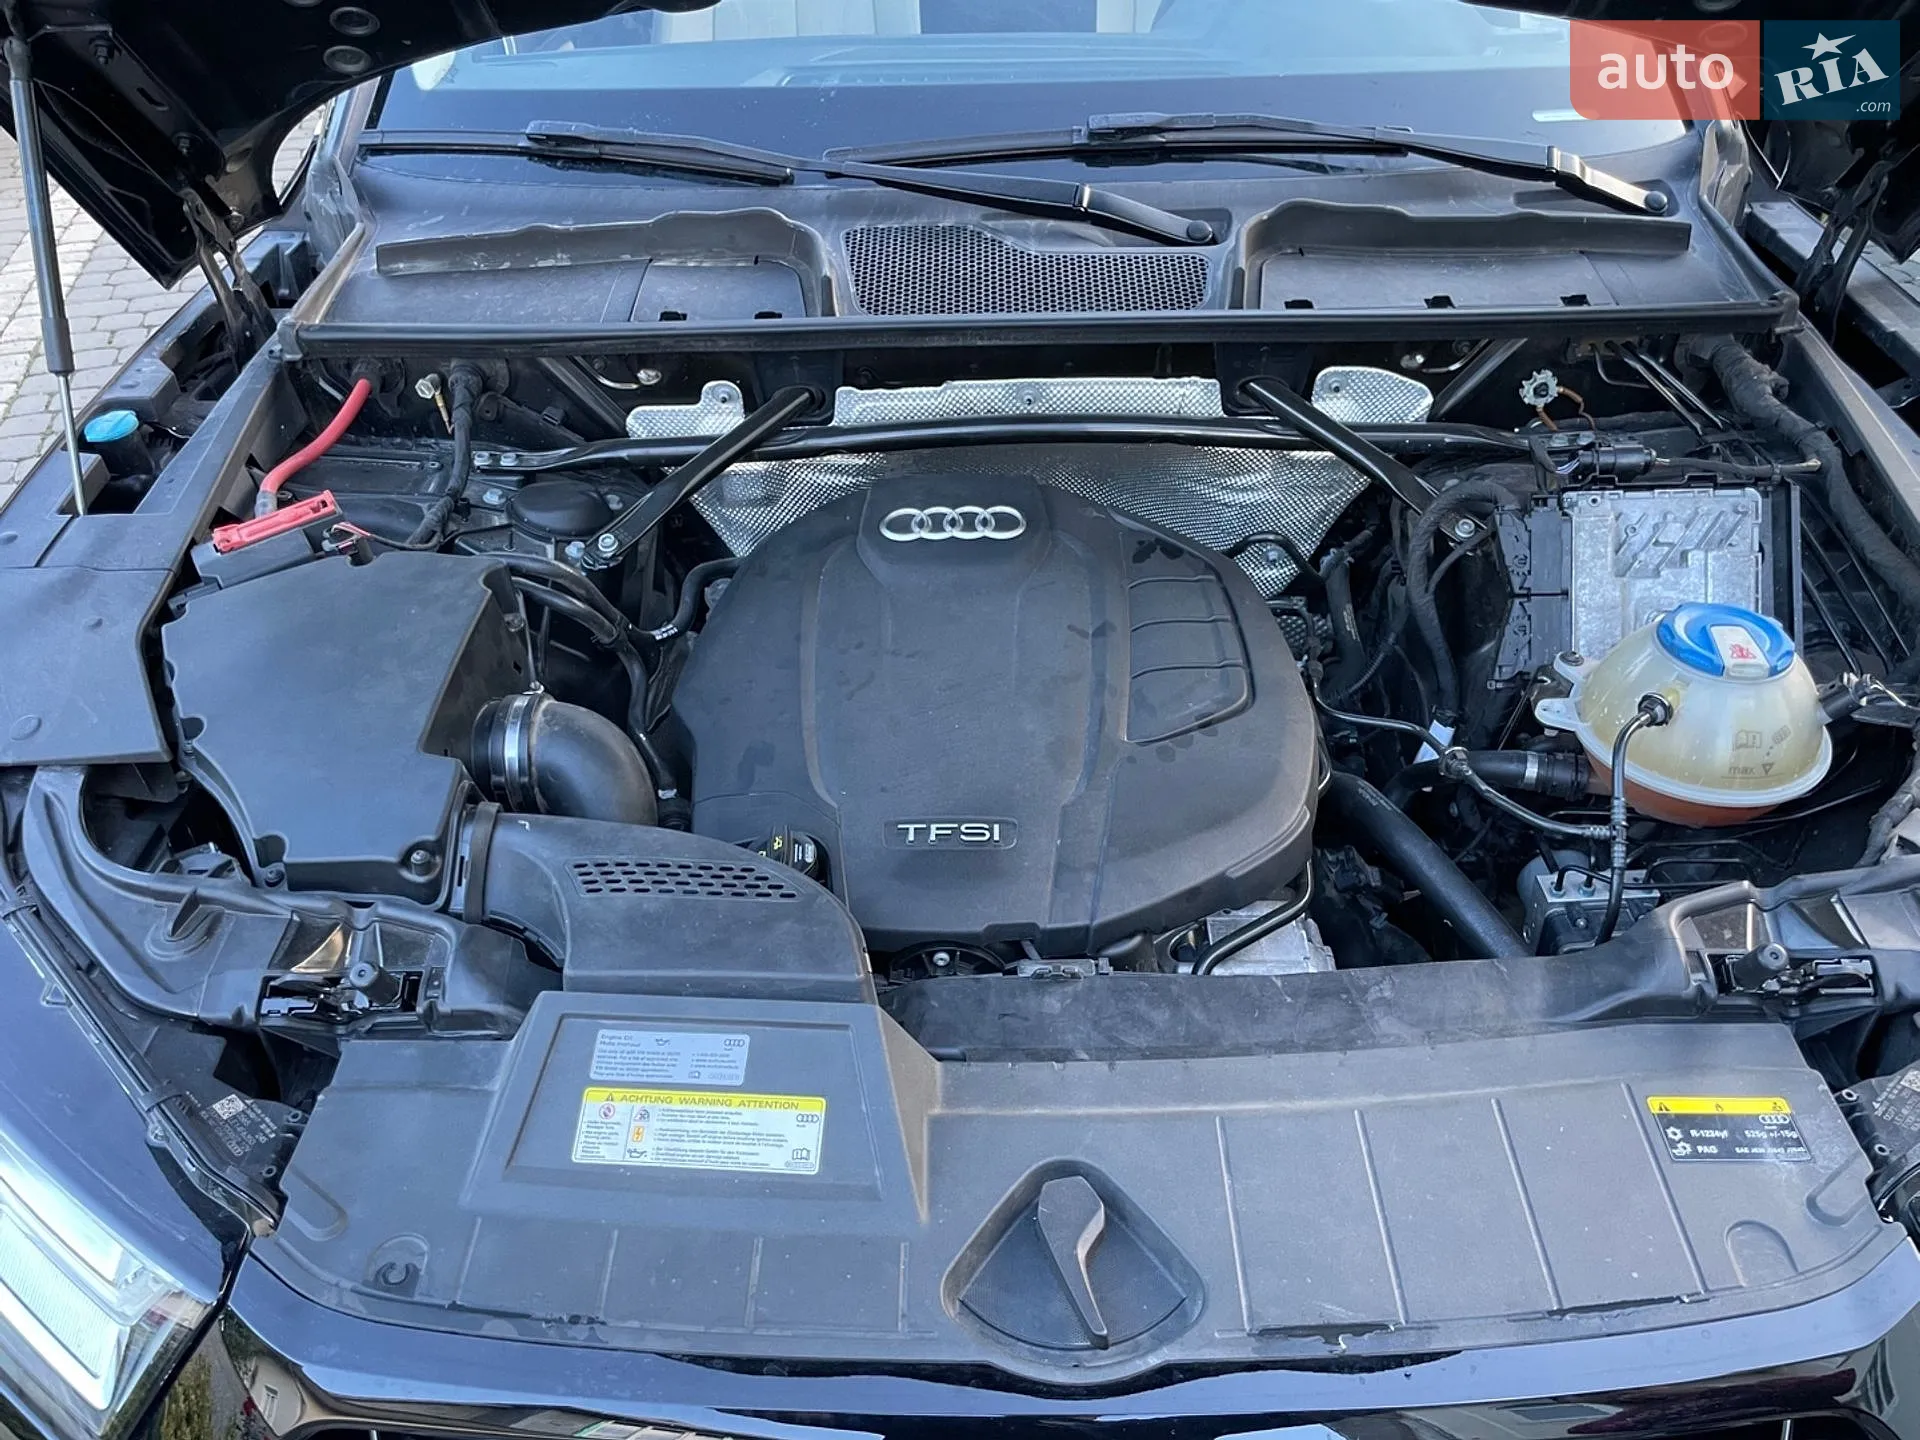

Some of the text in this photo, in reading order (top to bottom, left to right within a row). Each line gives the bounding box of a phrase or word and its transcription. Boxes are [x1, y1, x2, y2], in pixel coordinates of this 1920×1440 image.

[1728, 764, 1756, 775] max
[897, 823, 1000, 842] TFSI
[620, 1093, 800, 1110] ACHTUNG WARNING ATTENTION
